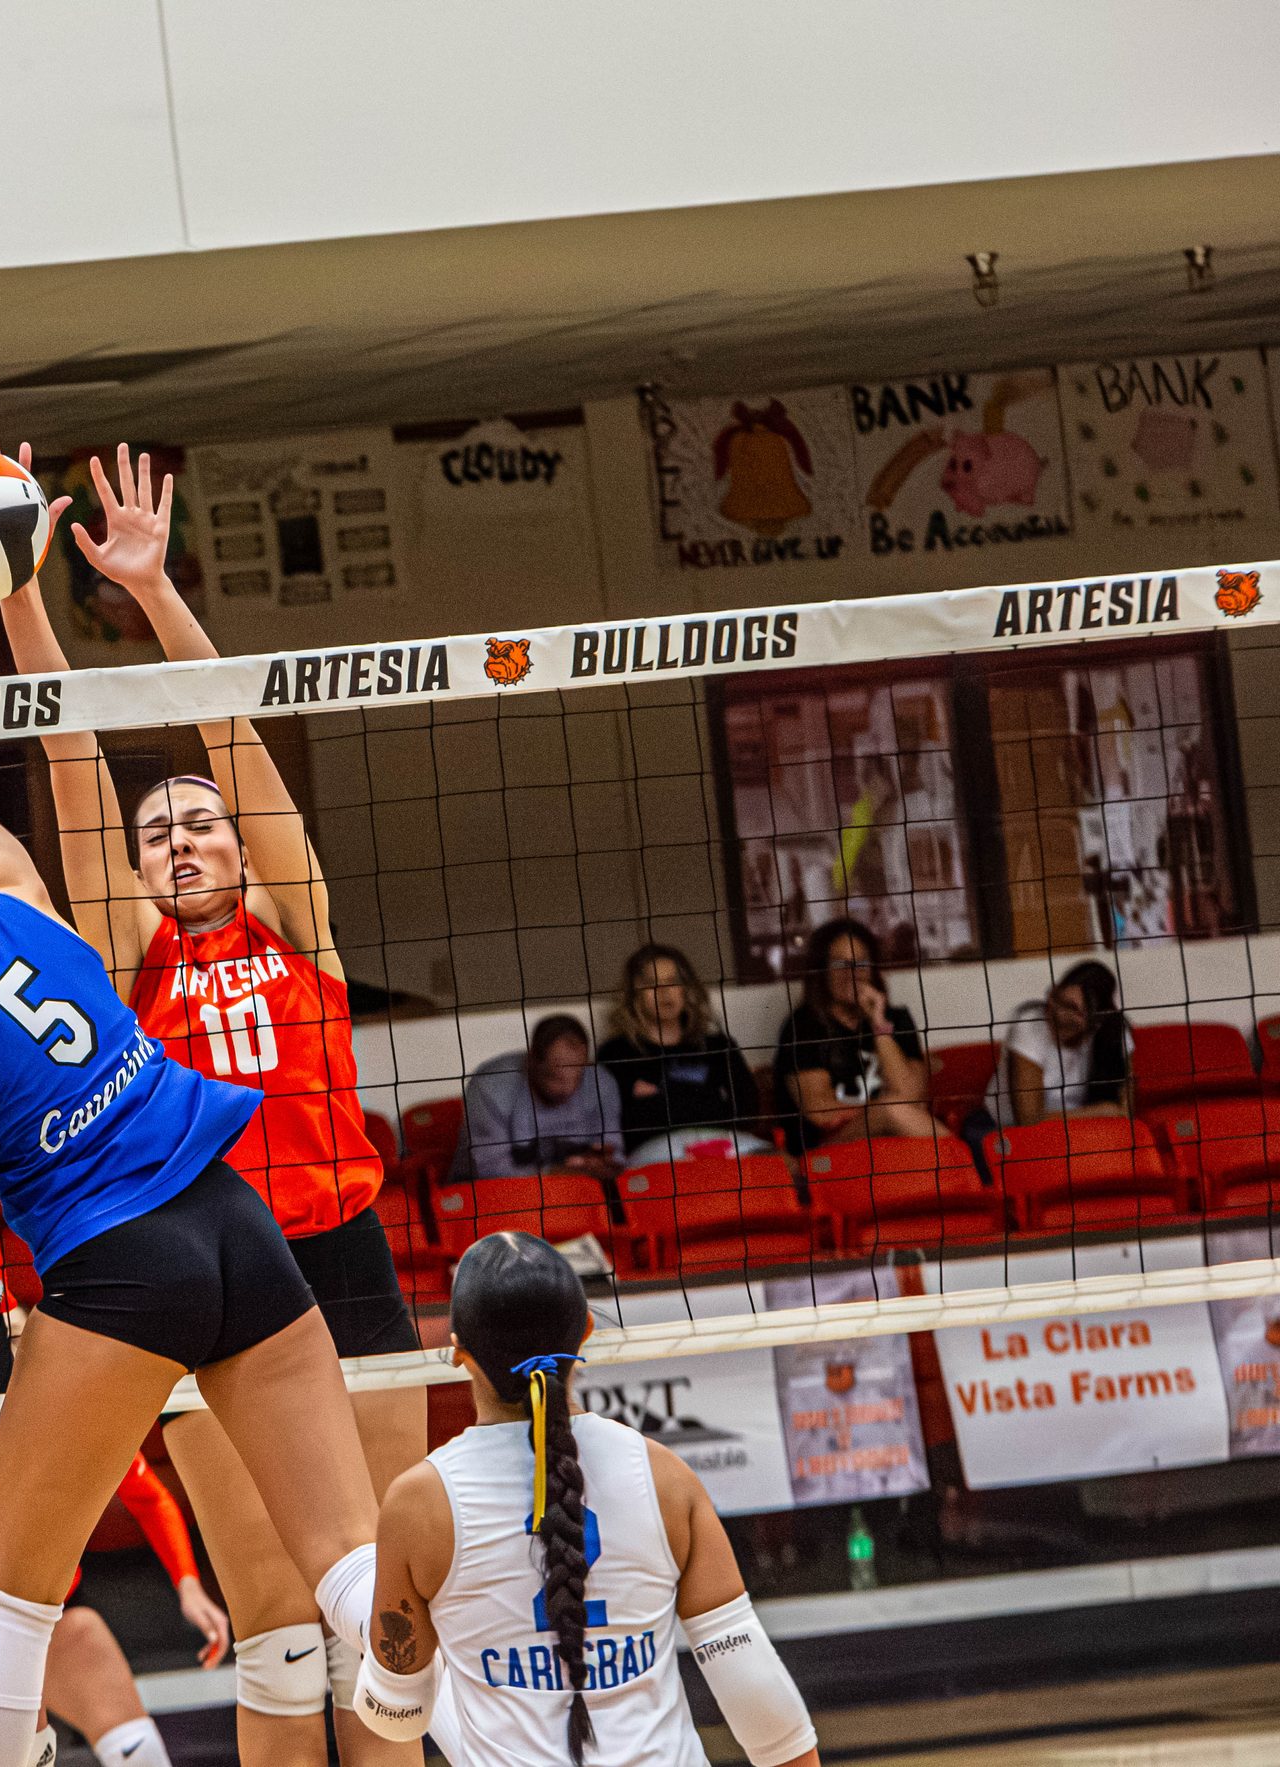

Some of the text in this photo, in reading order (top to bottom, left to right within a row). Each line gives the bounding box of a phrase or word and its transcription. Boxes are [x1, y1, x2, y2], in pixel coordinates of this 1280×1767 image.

[851, 374, 974, 434] BANK
[1094, 358, 1220, 413] BANK
[440, 442, 563, 486] CLOUDY
[676, 538, 746, 569] NEVER
[752, 537, 806, 564] GIVE
[869, 511, 915, 555] Be
[259, 645, 450, 707] ARTESIA
[570, 612, 798, 679] BULLDOGS
[992, 576, 1180, 638] ARTESIA
[170, 945, 290, 1004] ARTESIA
[199, 993, 279, 1076] 10
[980, 1320, 1152, 1361] La Clara
[954, 1378, 1056, 1416] Vista
[1070, 1366, 1197, 1404] Farms
[694, 1633, 753, 1661] Tandem
